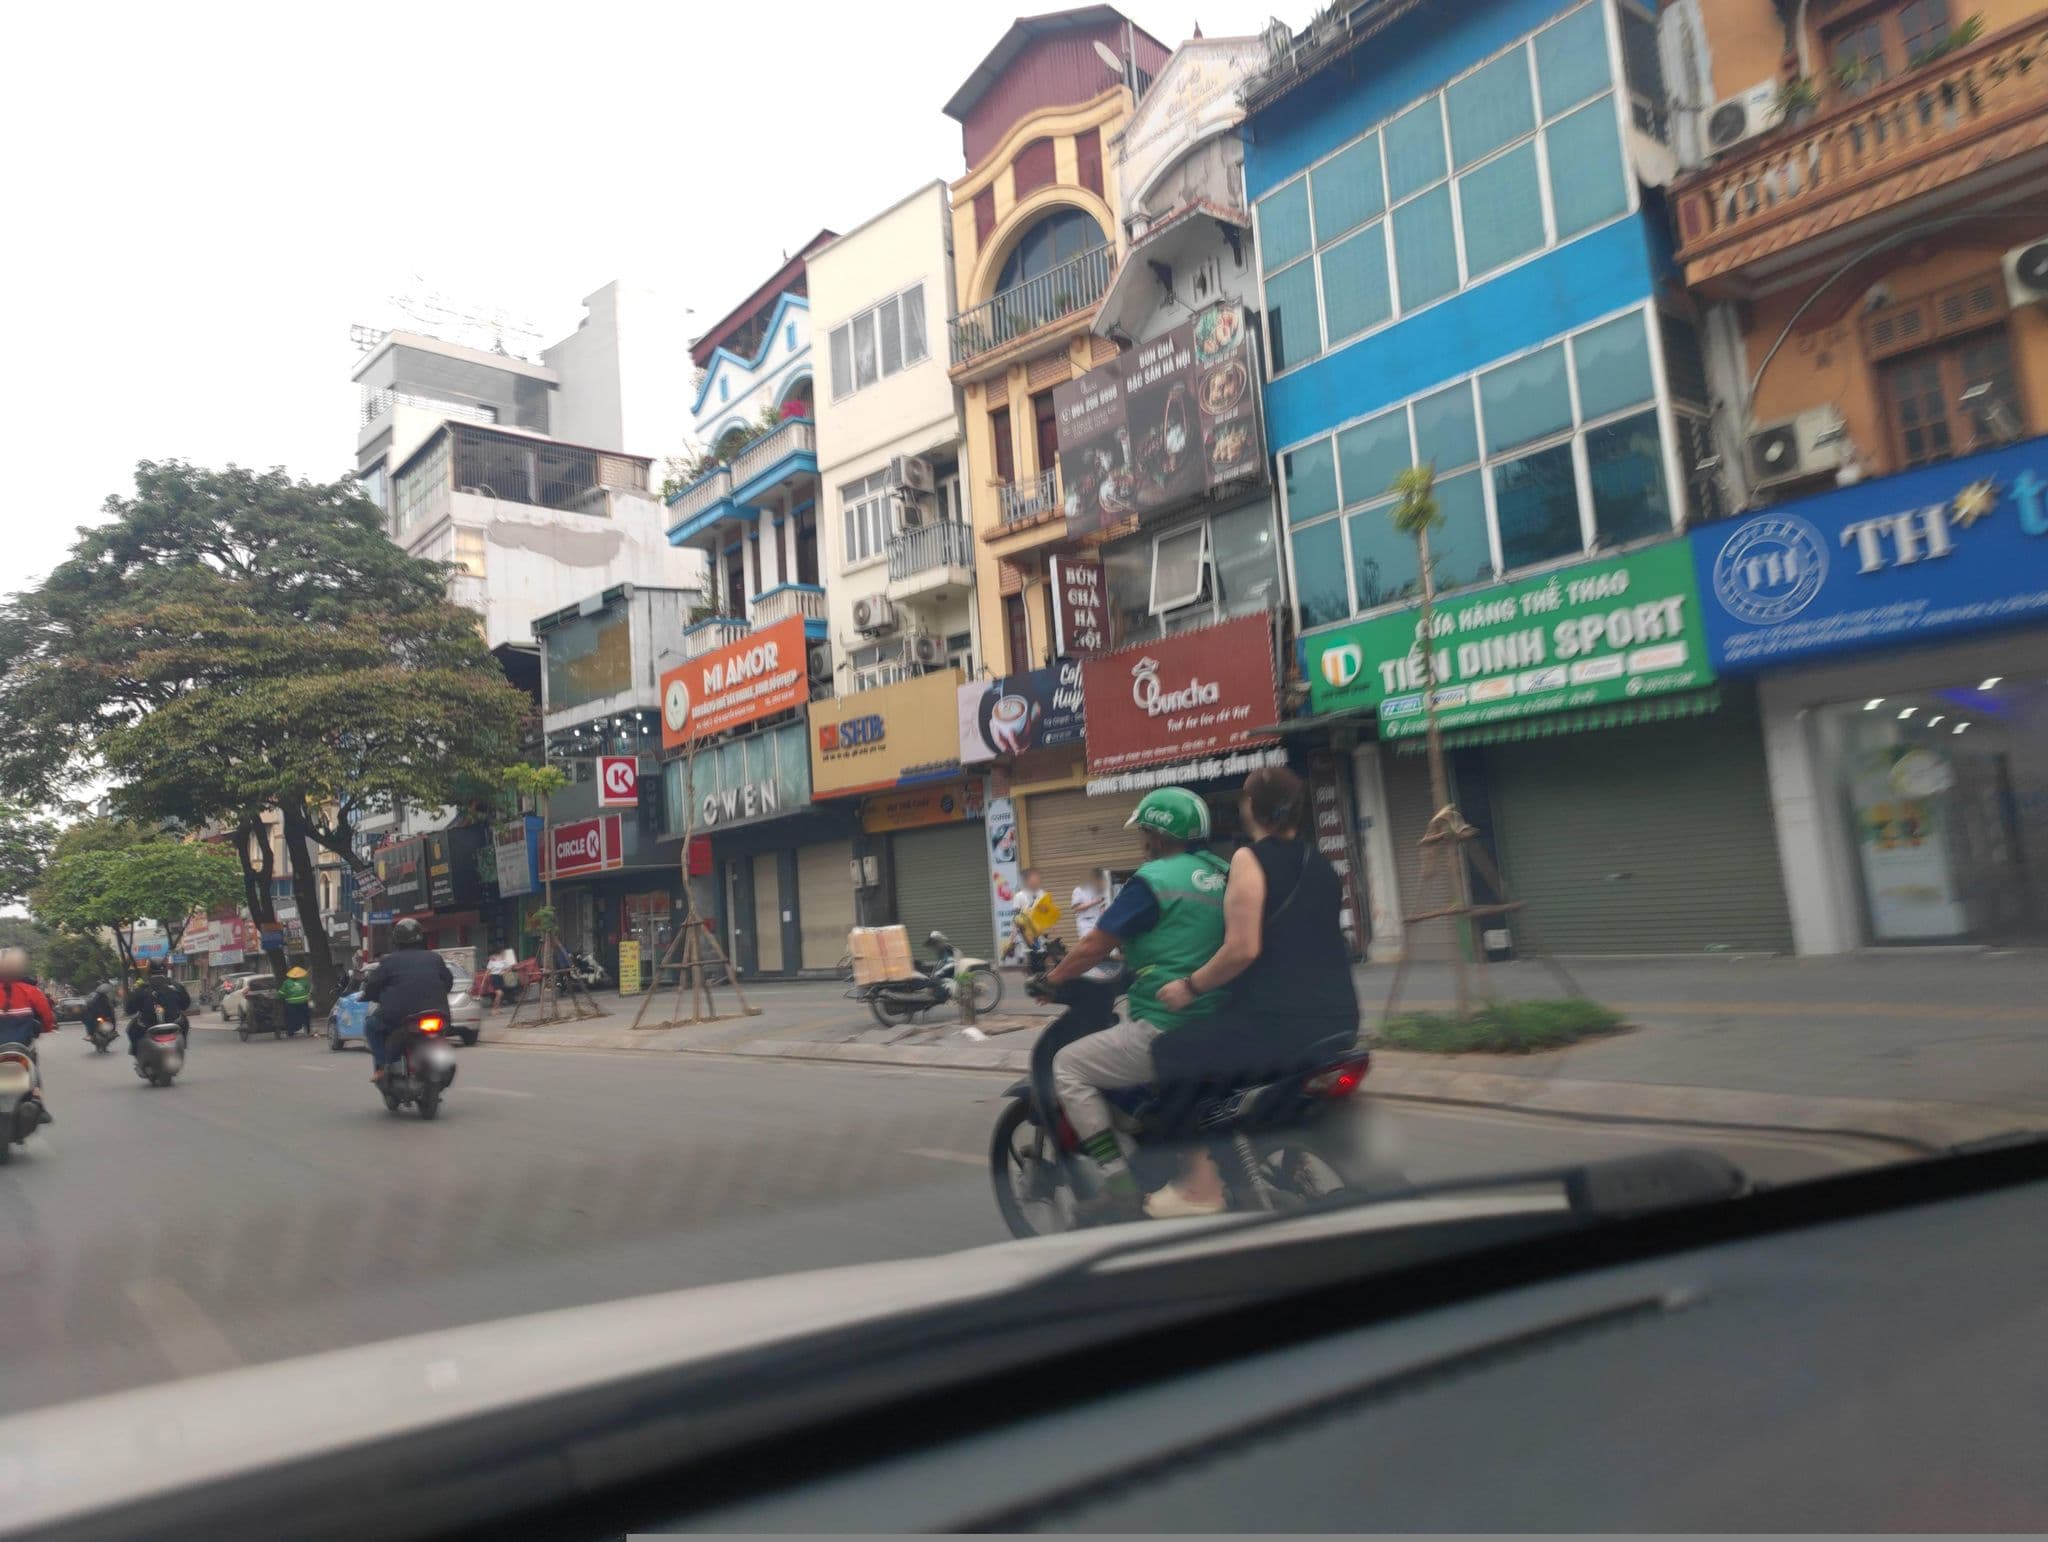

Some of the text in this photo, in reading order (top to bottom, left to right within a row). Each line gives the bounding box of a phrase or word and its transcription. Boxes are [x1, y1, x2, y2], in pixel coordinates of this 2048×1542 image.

[1840, 502, 1958, 575] TH
[1065, 564, 1098, 586] BÚN
[1566, 569, 1630, 606] THAO
[1074, 607, 1098, 628] HÀ
[1457, 627, 1546, 680] DINH
[1553, 594, 1686, 660] SPORT
[703, 663, 724, 696] MI
[726, 641, 778, 687] AMOR
[840, 712, 885, 749] SHB
[703, 778, 777, 826] OWEN
[556, 830, 599, 859] CIRCLE K
